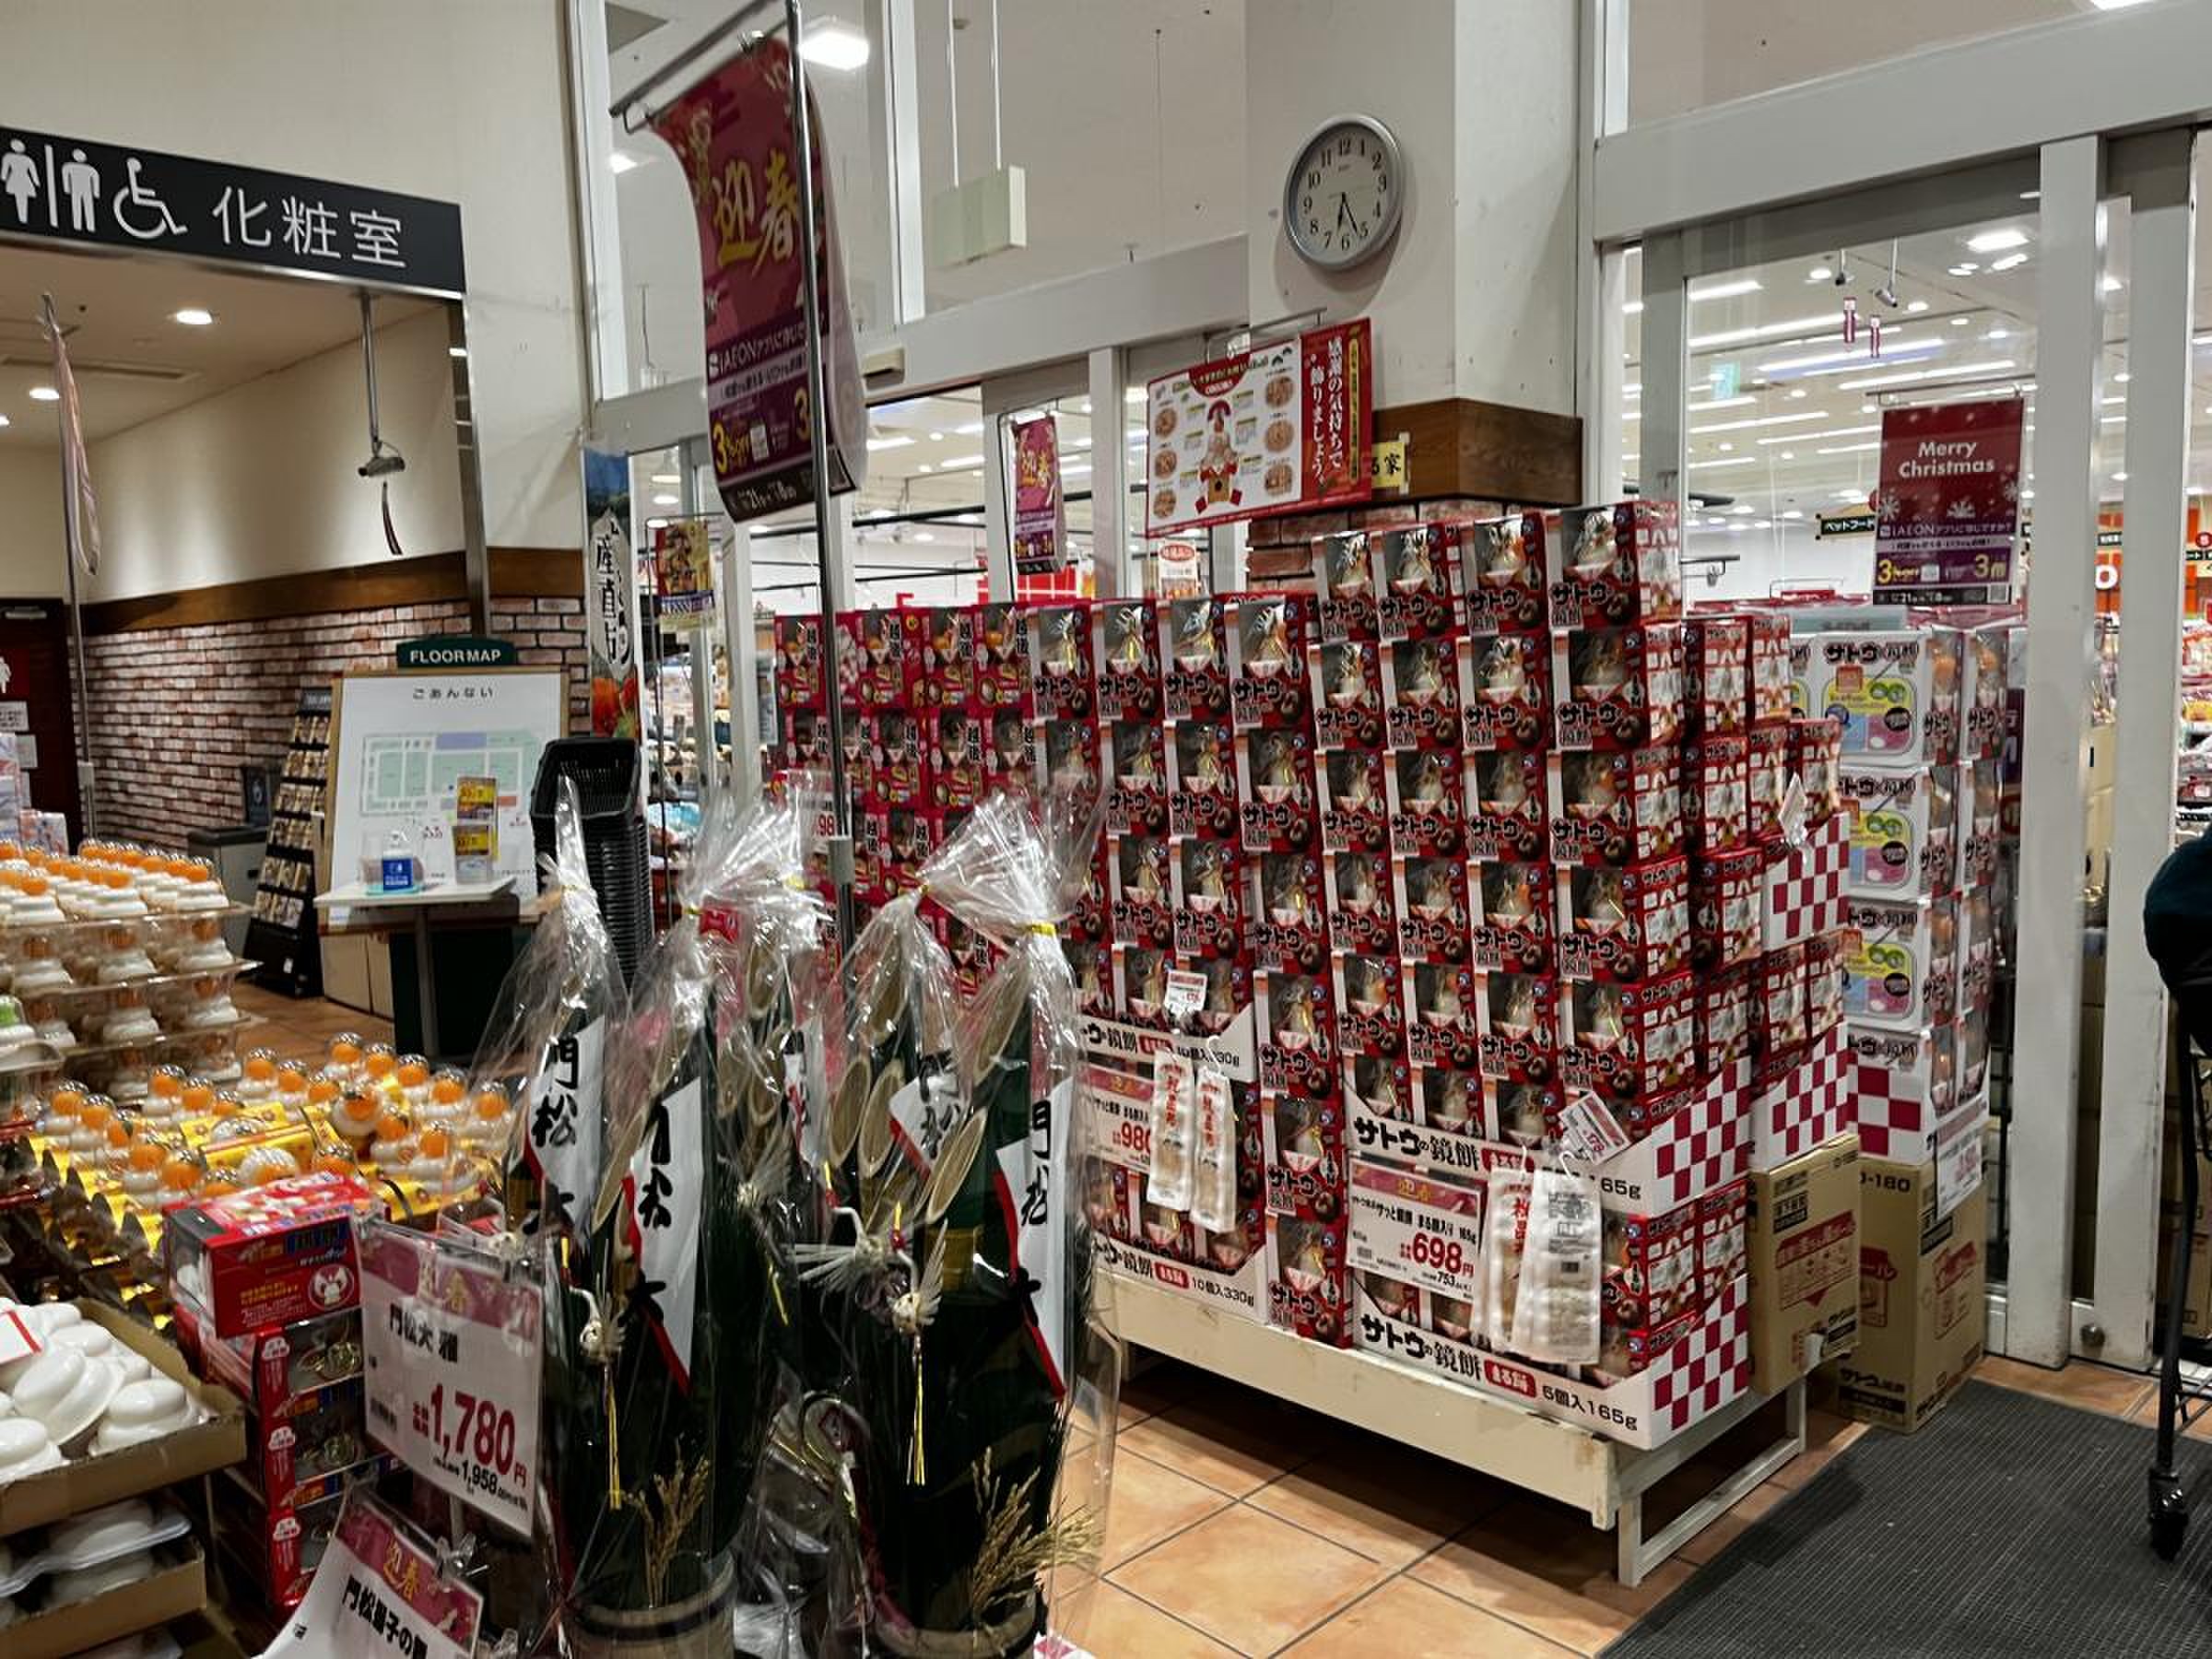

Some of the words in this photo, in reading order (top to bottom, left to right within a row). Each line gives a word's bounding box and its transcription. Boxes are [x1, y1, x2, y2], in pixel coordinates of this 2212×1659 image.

[213, 187, 406, 267] 化粧室
[1899, 460, 1995, 478] Christmas
[1918, 441, 1977, 458] Merry
[410, 649, 465, 664] FLOOR
[466, 649, 501, 663] MAP
[531, 1036, 579, 1148] 門松
[1354, 1116, 1479, 1171] サトウの鏡餅
[1360, 1313, 1482, 1381] サトウの鏡餅
